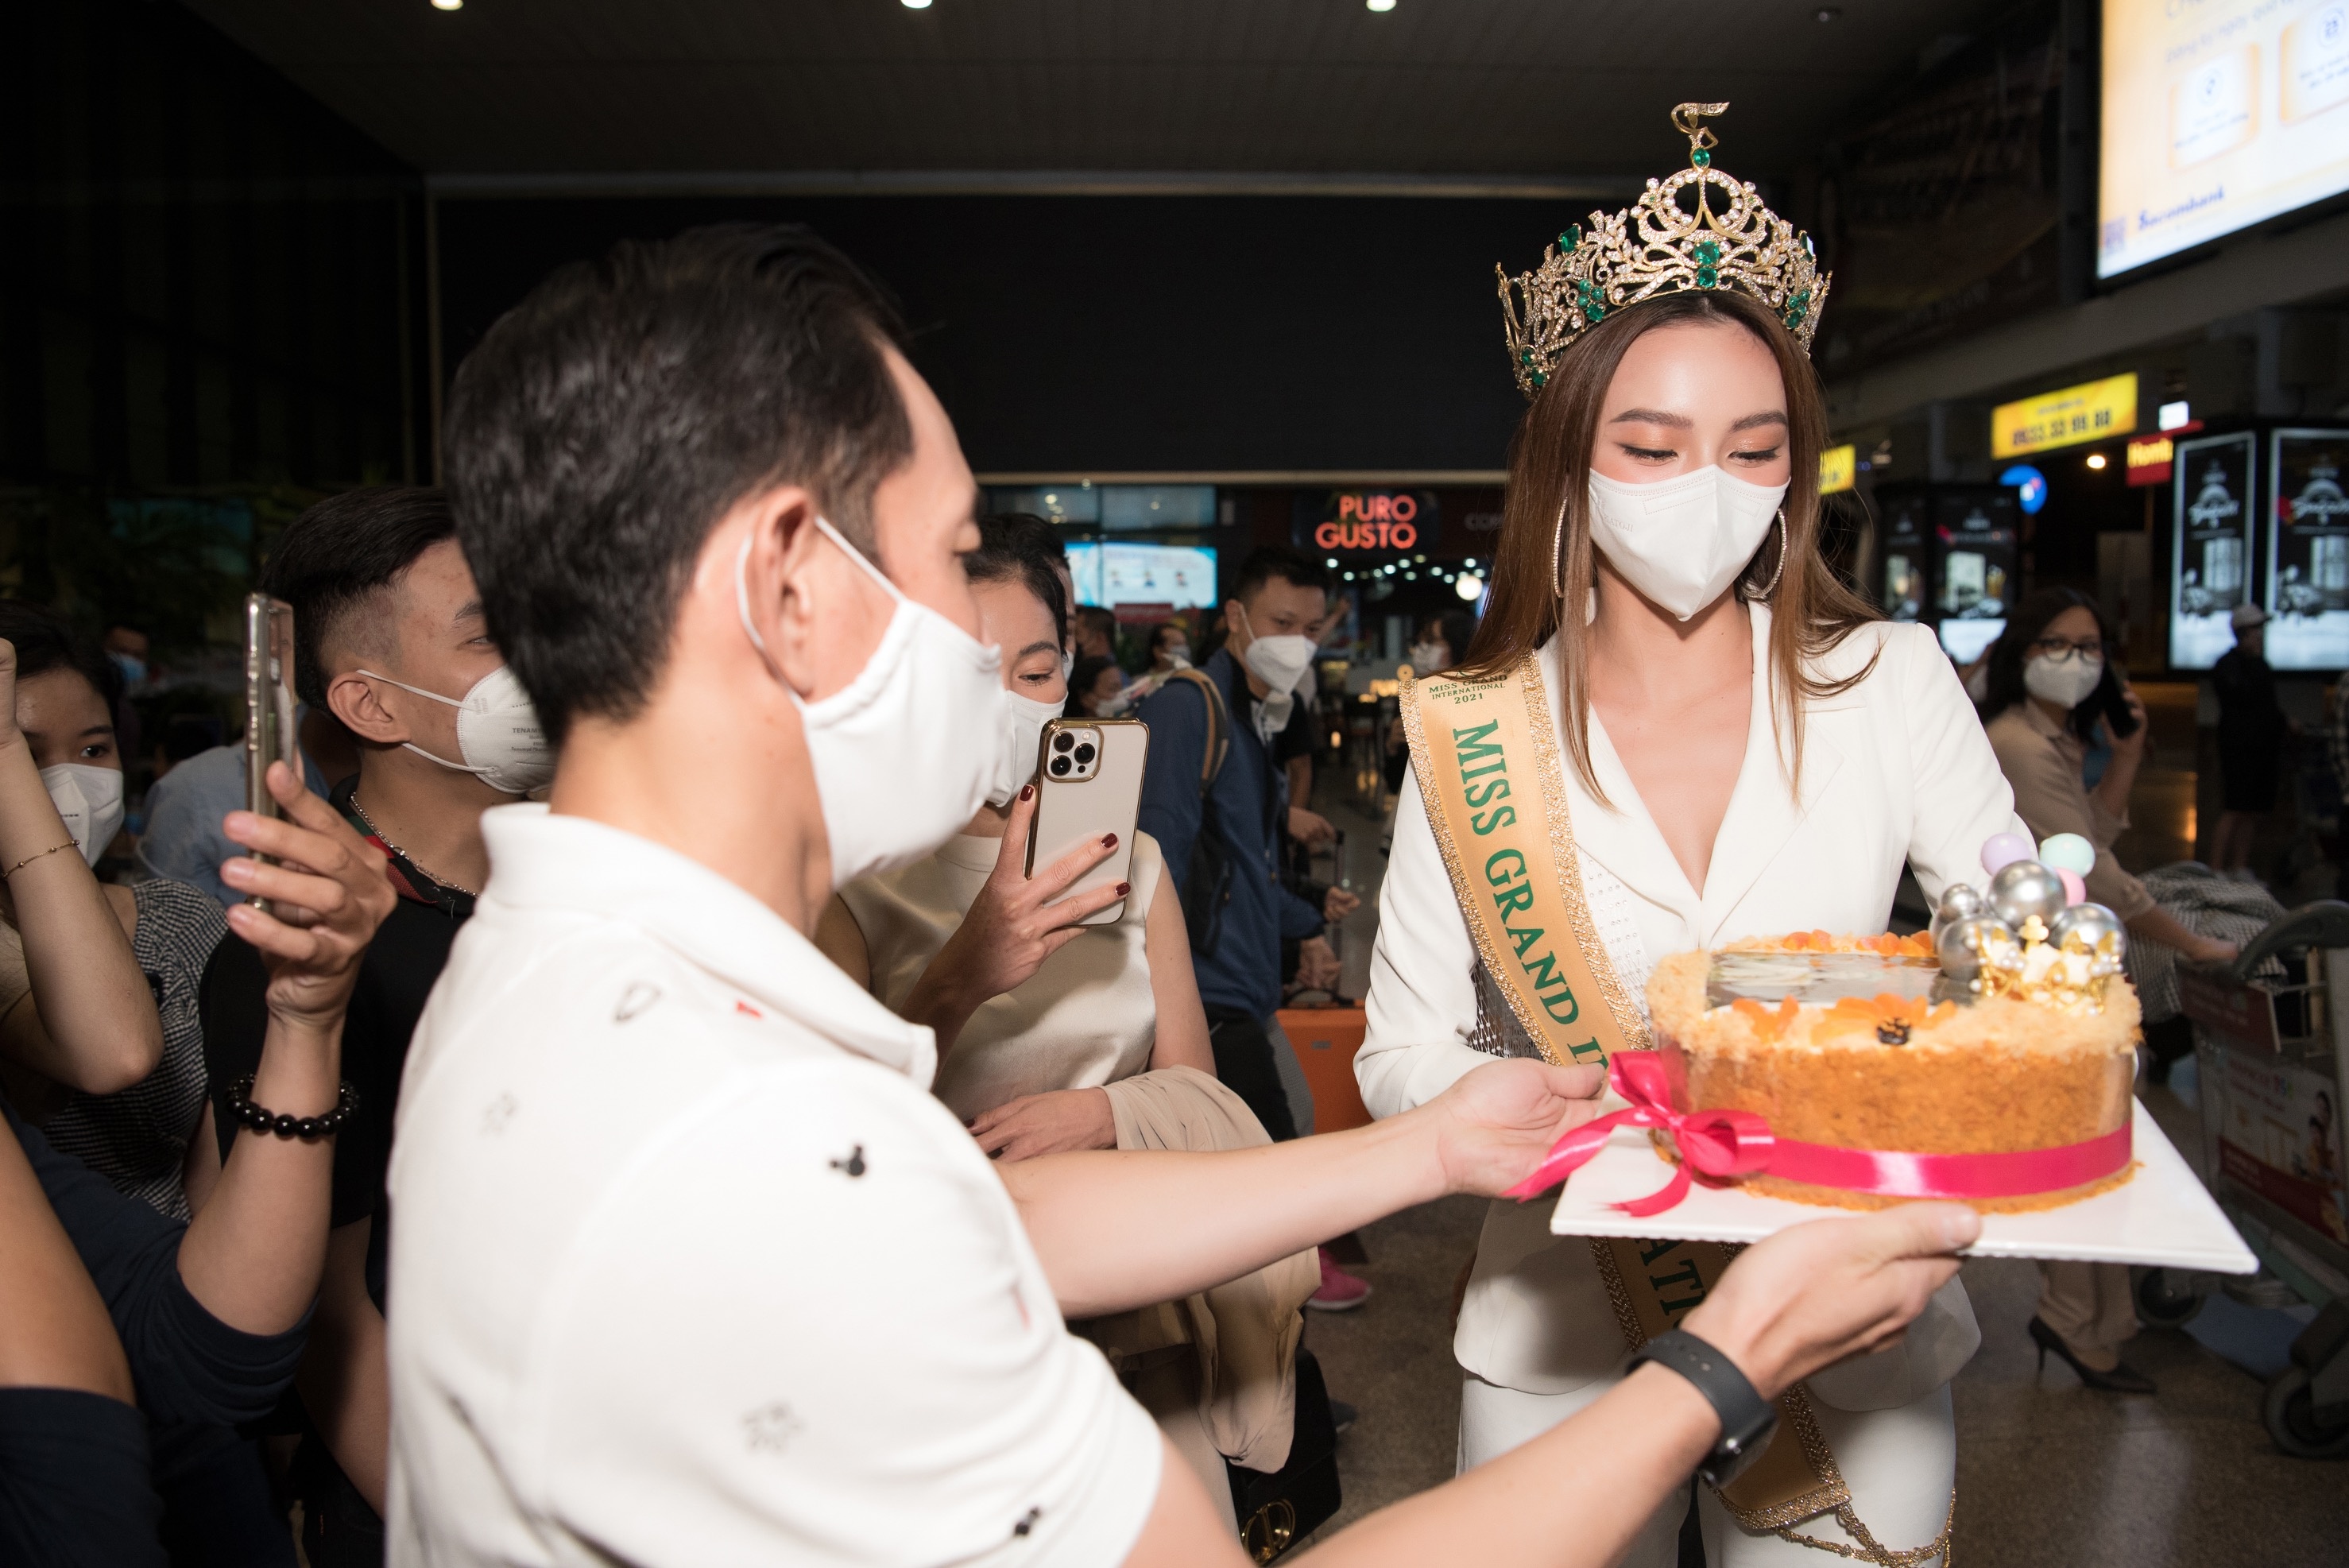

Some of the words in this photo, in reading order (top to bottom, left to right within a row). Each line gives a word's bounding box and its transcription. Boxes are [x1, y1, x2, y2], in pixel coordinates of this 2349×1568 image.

[1339, 494, 1418, 522] PURO
[1314, 521, 1418, 549] GUSTO
[1429, 682, 1457, 694] MISS
[1463, 675, 1508, 686] GRAND
[1431, 683, 1506, 699] INTERNATIONAL
[1453, 692, 1484, 704] 2021
[1453, 718, 1518, 837] MISS
[1484, 848, 1580, 1025] GRAND
